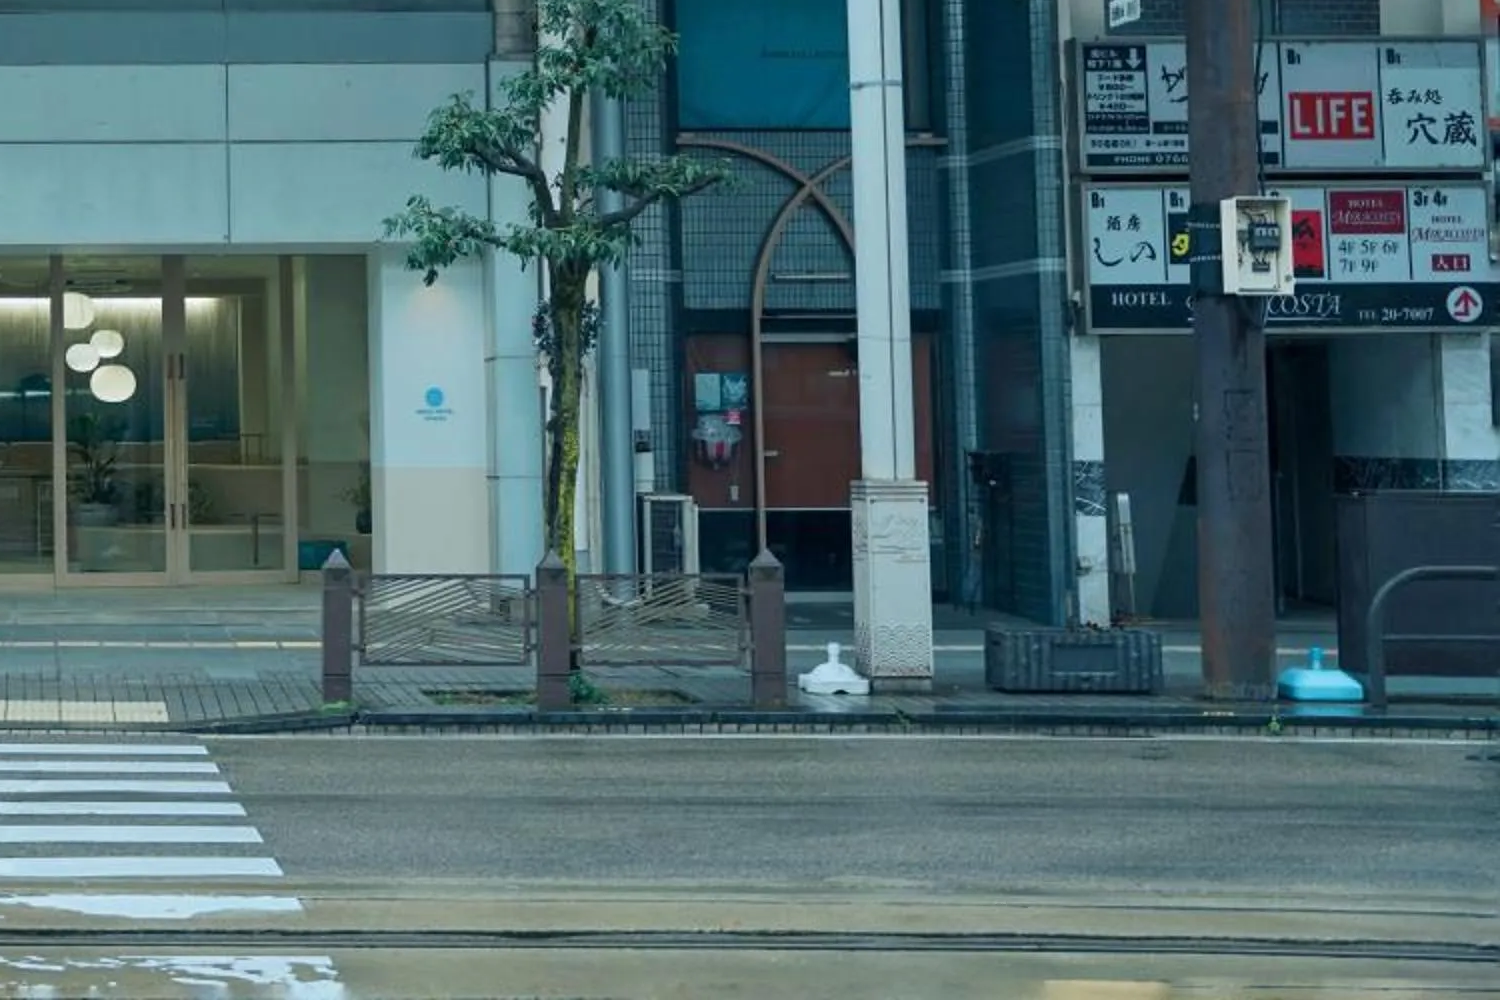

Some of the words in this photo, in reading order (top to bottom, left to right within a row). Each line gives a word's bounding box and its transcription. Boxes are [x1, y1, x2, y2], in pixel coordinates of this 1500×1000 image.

[1287, 48, 1301, 64] B1
[1386, 48, 1401, 64] B1
[1292, 97, 1372, 135] LIFE
[1406, 111, 1477, 147] 穴蔵
[1091, 192, 1105, 208] B1
[1169, 192, 1184, 207] B1
[1093, 237, 1157, 267] しの
[1338, 240, 1354, 254] 4F
[1361, 240, 1376, 254] 5F
[1339, 258, 1355, 273] 7F
[1361, 258, 1380, 273] 9F
[1436, 256, 1468, 271] 入口
[1111, 291, 1172, 307] HOTEL
